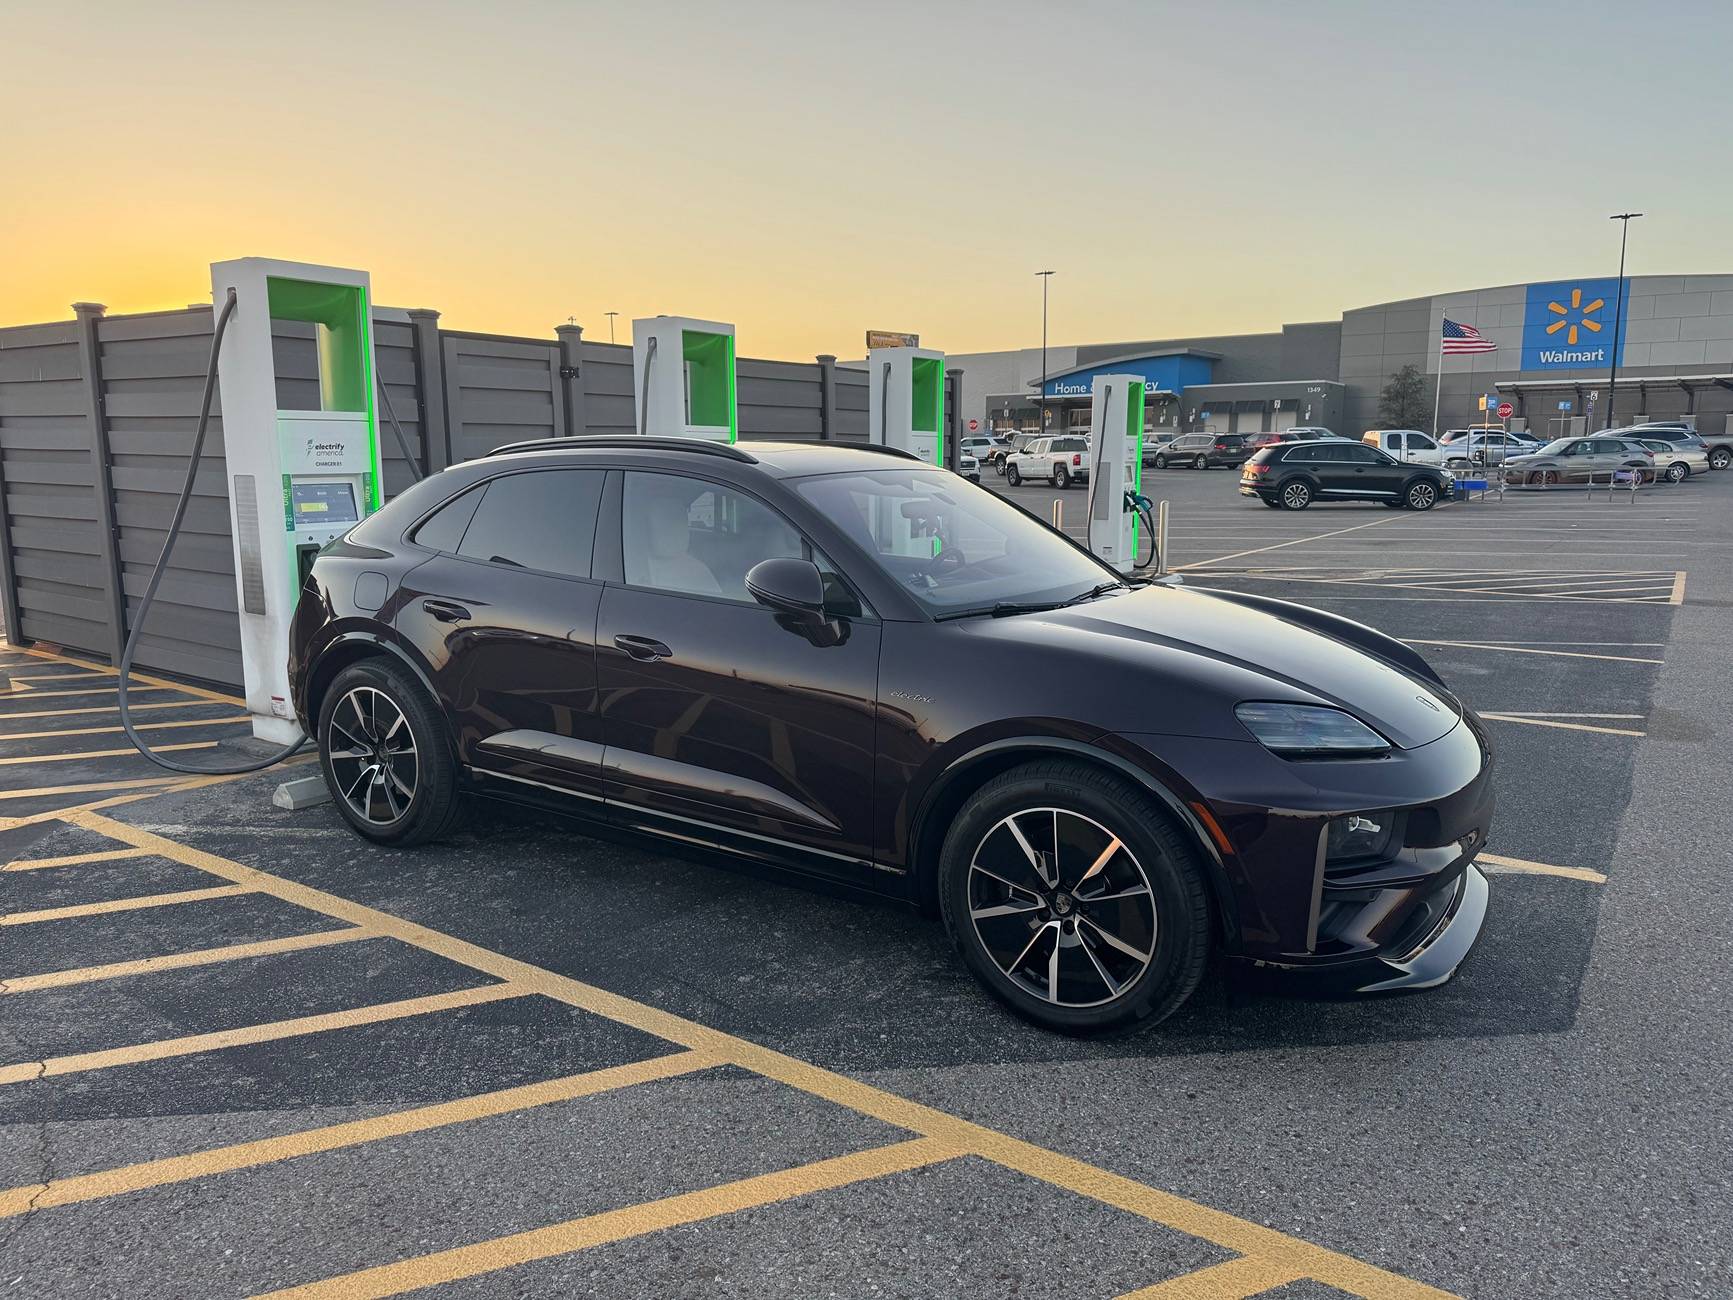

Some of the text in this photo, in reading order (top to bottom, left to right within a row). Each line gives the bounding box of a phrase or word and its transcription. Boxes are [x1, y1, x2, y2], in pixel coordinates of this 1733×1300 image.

[1540, 349, 1604, 363] Walmart
[1055, 382, 1087, 395] Home
[1498, 407, 1512, 415] STOP
[315, 443, 345, 451] electrify
